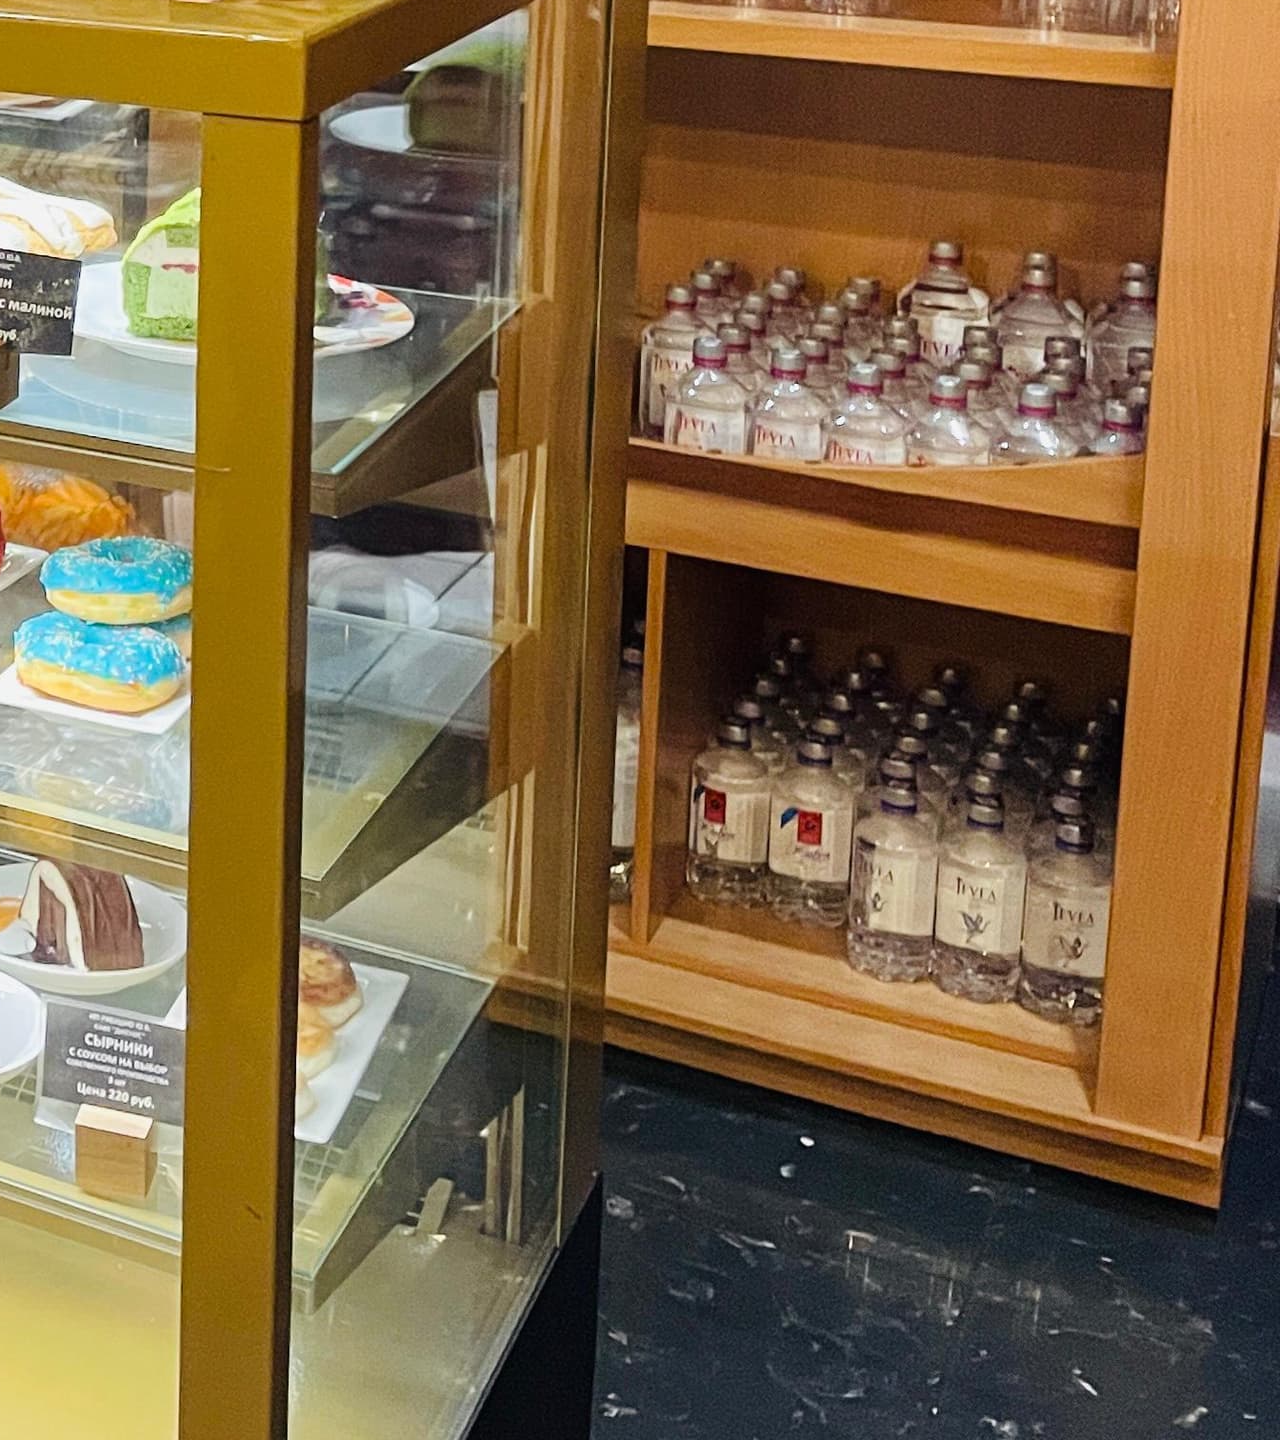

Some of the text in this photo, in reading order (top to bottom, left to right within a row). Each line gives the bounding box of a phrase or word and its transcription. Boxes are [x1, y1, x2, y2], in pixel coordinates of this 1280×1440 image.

[8, 299, 73, 320] малиной
[84, 1032, 154, 1058] СЫРНИКИ
[76, 1049, 118, 1065] СОУСОМ
[119, 1057, 133, 1069] НА
[76, 1081, 106, 1098] Цена
[130, 1095, 155, 1109] руб.
